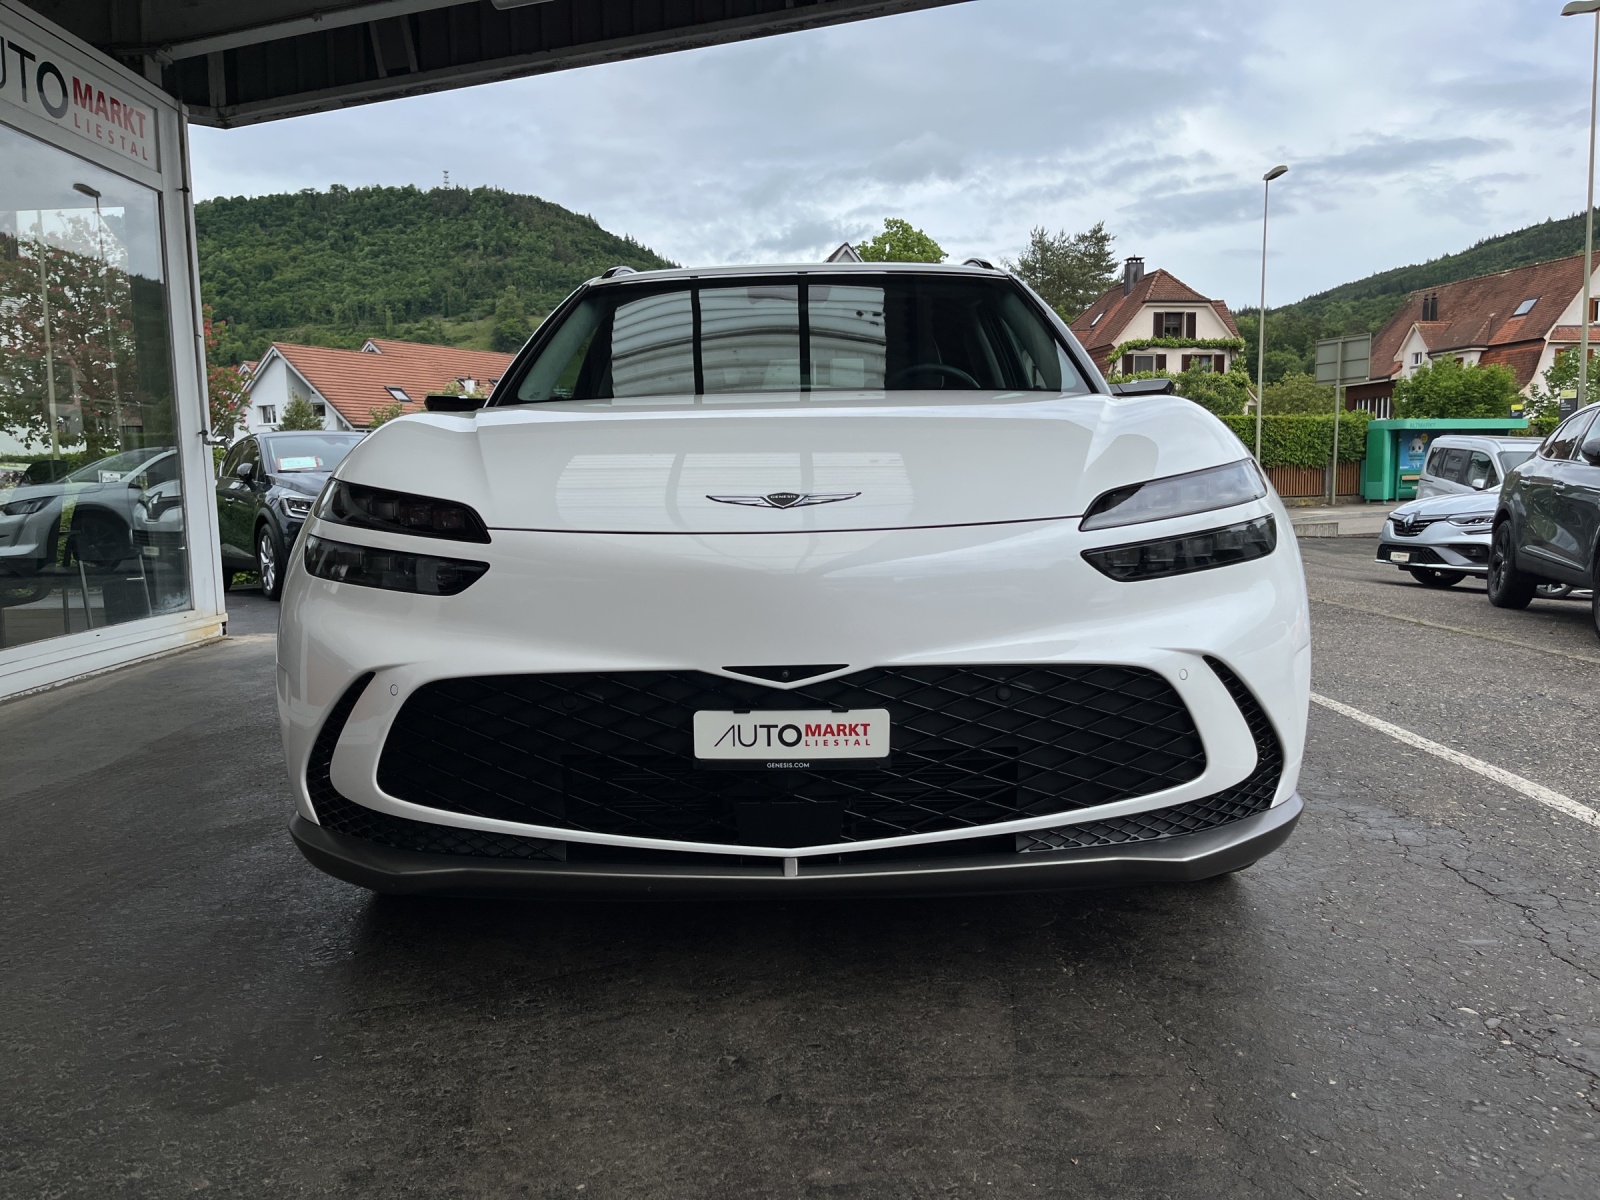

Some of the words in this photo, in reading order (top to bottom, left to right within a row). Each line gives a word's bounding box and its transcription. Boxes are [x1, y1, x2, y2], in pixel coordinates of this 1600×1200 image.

[72, 76, 146, 139] MARKT
[74, 112, 148, 161] LIESTAL
[714, 724, 803, 748] AUTO
[804, 723, 871, 737] MARKT
[804, 739, 871, 747] LIESTAL
